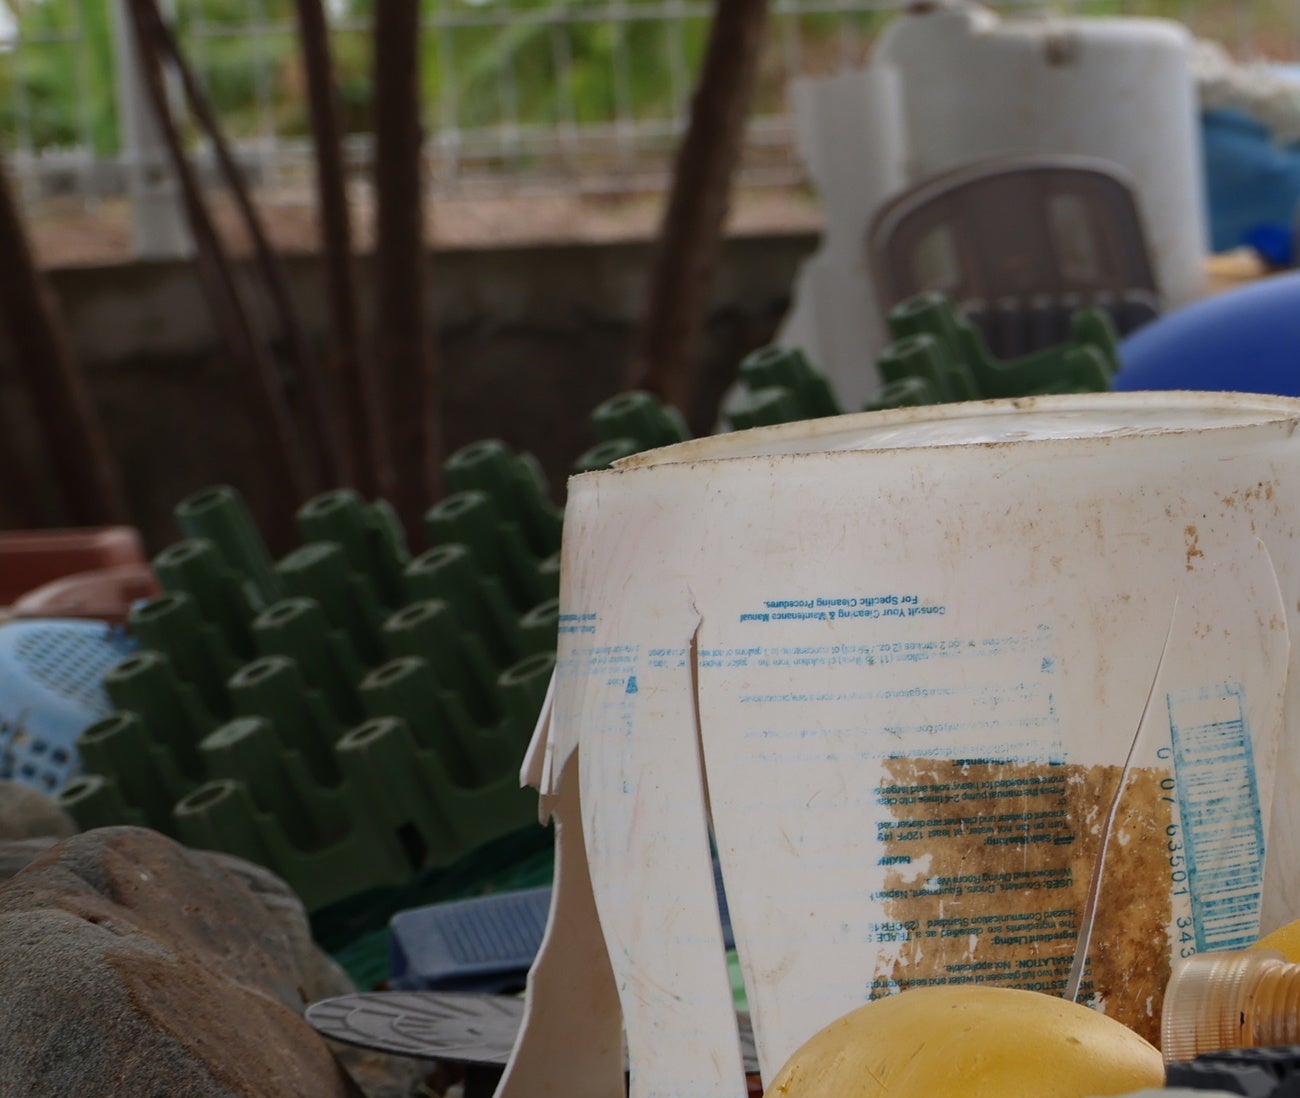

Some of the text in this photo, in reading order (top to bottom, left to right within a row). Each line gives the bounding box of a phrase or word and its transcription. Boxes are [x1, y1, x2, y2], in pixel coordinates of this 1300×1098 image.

[763, 595, 918, 610] For Specific Cleaning Procedures.
[829, 611, 836, 620] &
[882, 608, 905, 618] Your
[907, 606, 946, 617] Consult
[740, 614, 769, 623] Manual
[771, 612, 827, 622] Maintenance
[1164, 823, 1189, 895] 63501
[970, 912, 1042, 924] Communication
